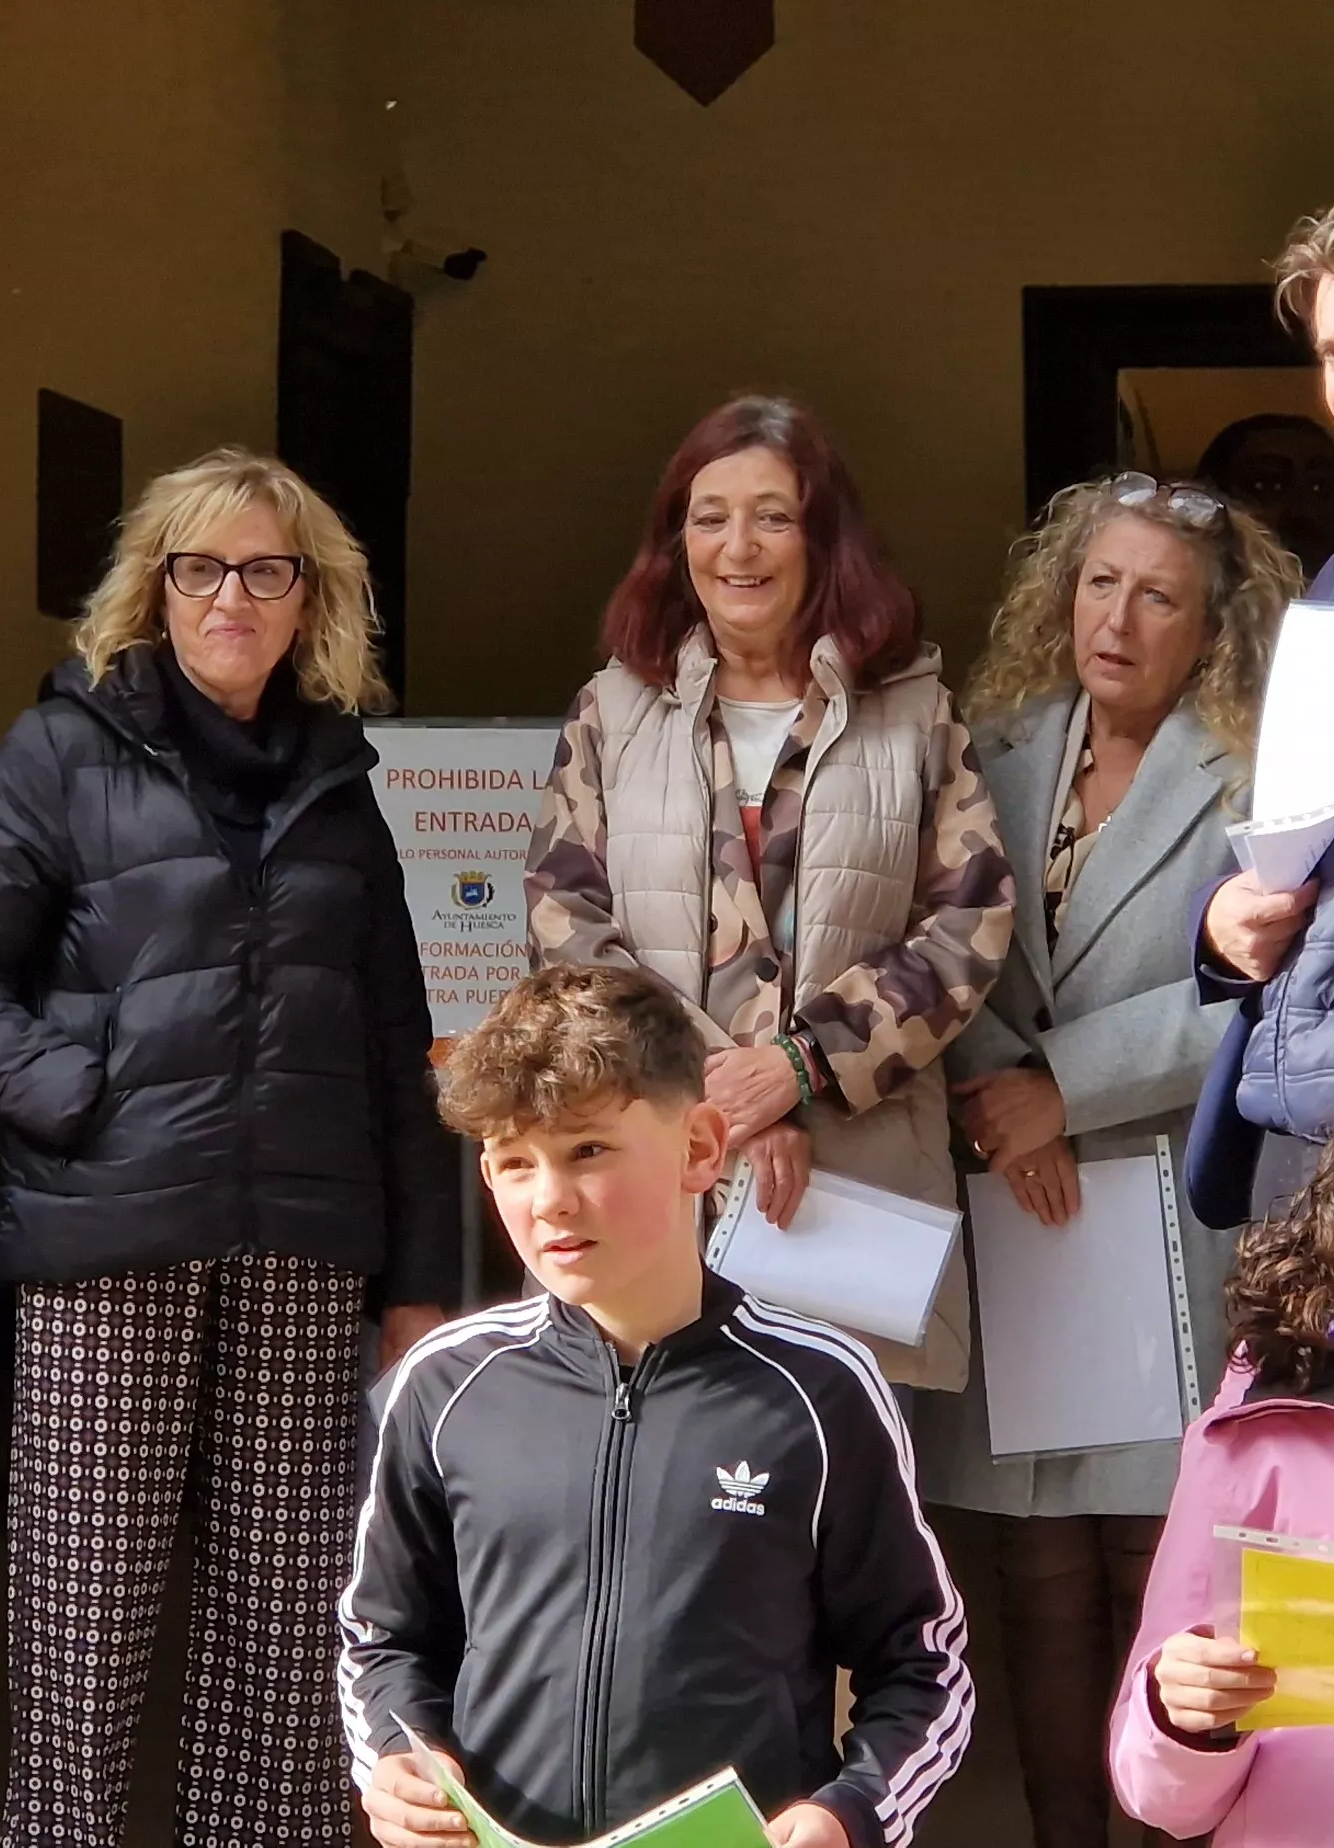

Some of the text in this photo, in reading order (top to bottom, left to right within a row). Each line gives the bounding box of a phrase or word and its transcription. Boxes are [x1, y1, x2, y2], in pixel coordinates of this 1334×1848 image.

[387, 768, 547, 790] PROHIBIDA L
[415, 811, 532, 833] ENTRADA
[399, 848, 527, 860] LO PERSONAL AUTOR
[419, 939, 528, 958] FORMACIÓN
[422, 966, 521, 981] TRADA POR
[427, 988, 510, 1004] TRA PUER
[710, 1497, 765, 1516] adidas
